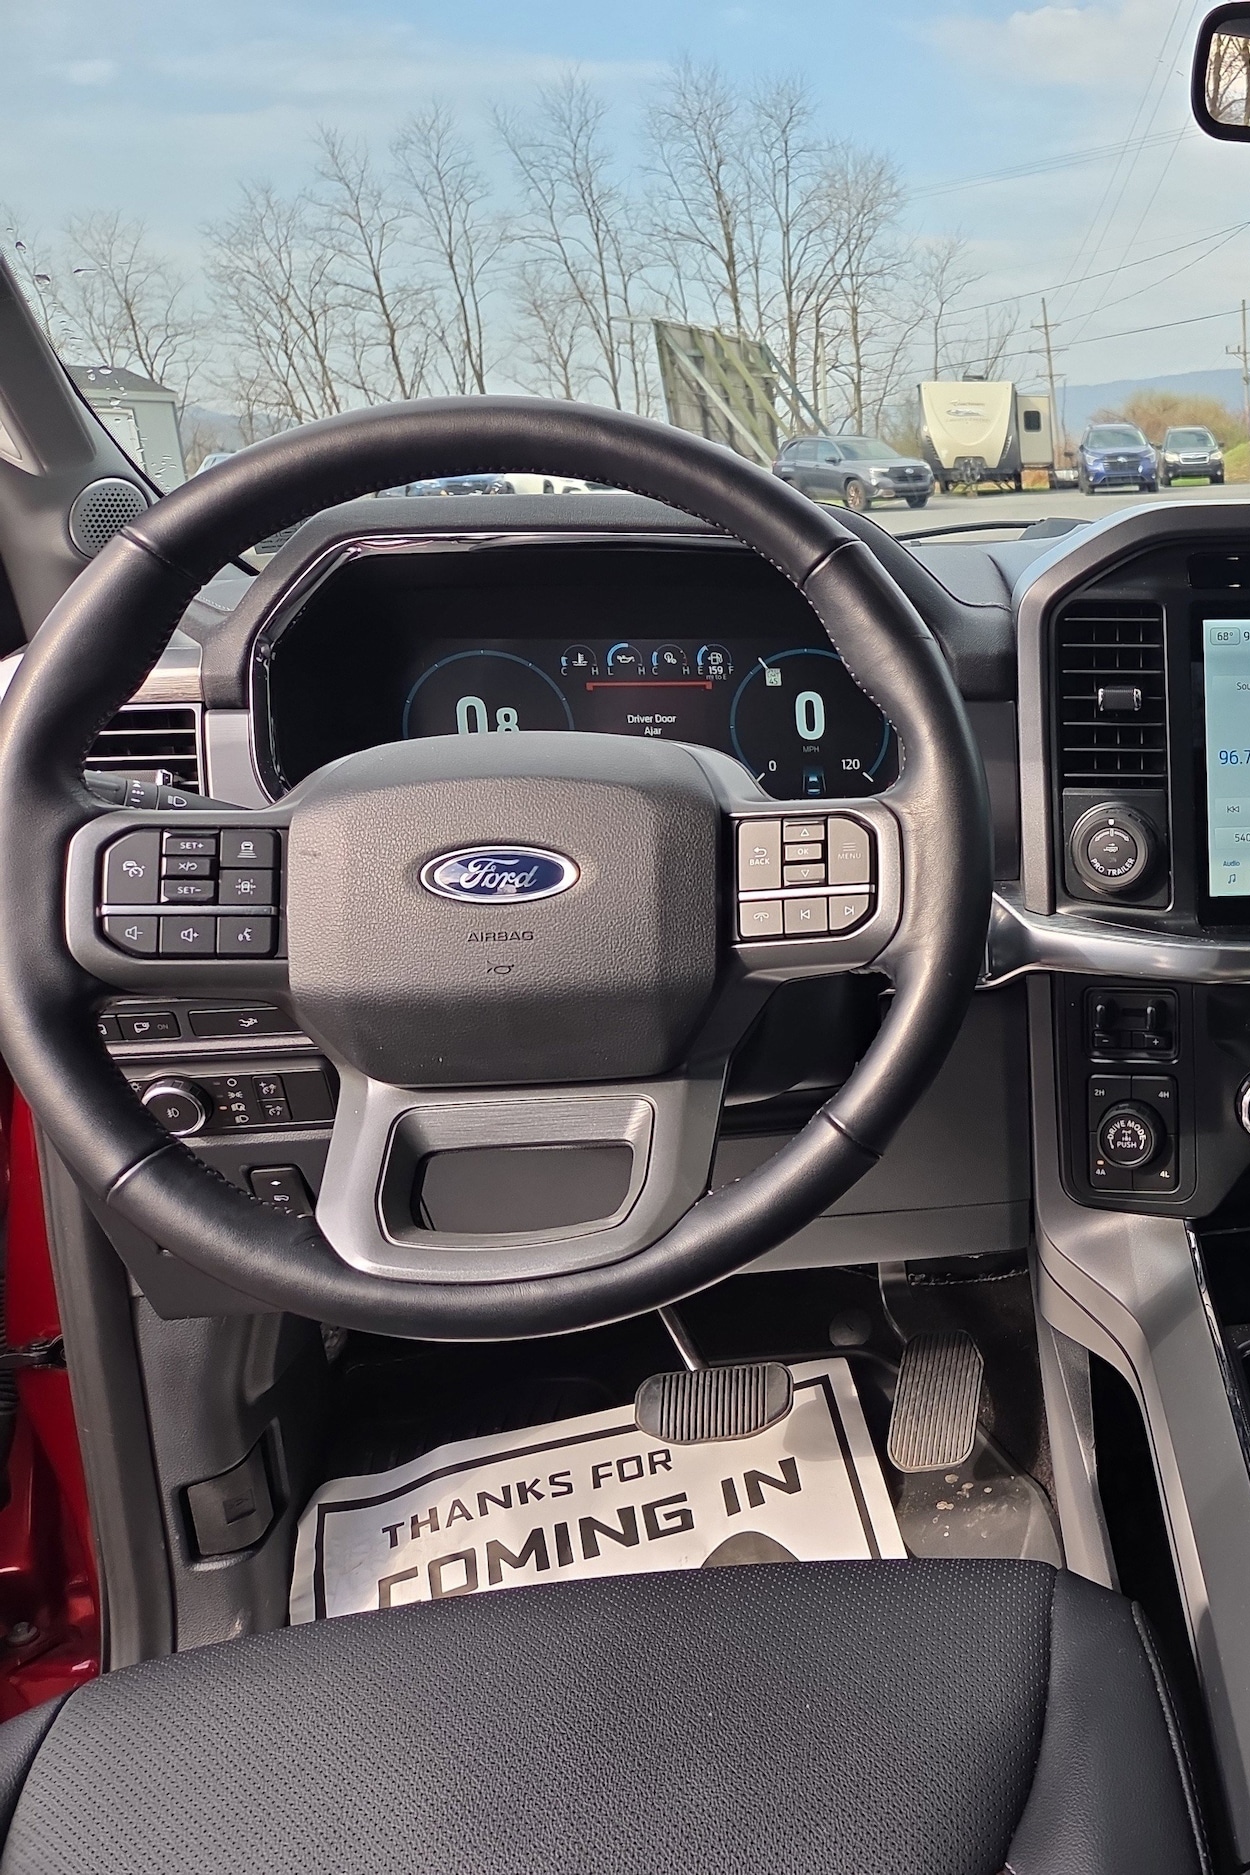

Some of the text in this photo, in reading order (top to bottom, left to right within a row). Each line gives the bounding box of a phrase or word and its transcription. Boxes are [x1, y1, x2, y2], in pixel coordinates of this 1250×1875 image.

[1217, 631, 1234, 641] 68°
[560, 667, 568, 676] C
[591, 666, 599, 676] H
[607, 667, 614, 675] L
[638, 666, 646, 675] H
[651, 666, 658, 675] C
[682, 666, 690, 675] H
[698, 666, 704, 675] E
[708, 665, 724, 675] 159
[728, 666, 734, 675] F
[627, 714, 677, 724] Driver Door
[795, 691, 825, 740] 0
[644, 726, 662, 736] Ajar
[768, 760, 777, 771] 0
[841, 758, 860, 770] 120
[797, 848, 809, 856] OK
[837, 852, 862, 860] MENU
[749, 857, 770, 866] BACK
[1222, 860, 1241, 868] Audio
[1091, 857, 1136, 876] PRO TRAILER
[459, 857, 539, 889] Ford
[467, 931, 534, 942] AIRBAG
[1094, 1088, 1105, 1097] 2H
[1158, 1091, 1170, 1099] 4H
[1107, 1120, 1147, 1140] DRIVE MODE
[1095, 1168, 1106, 1176] 4A
[1159, 1170, 1170, 1178] 4L
[381, 1448, 672, 1549] THANKS FOR
[377, 1456, 802, 1608] COMING IN
